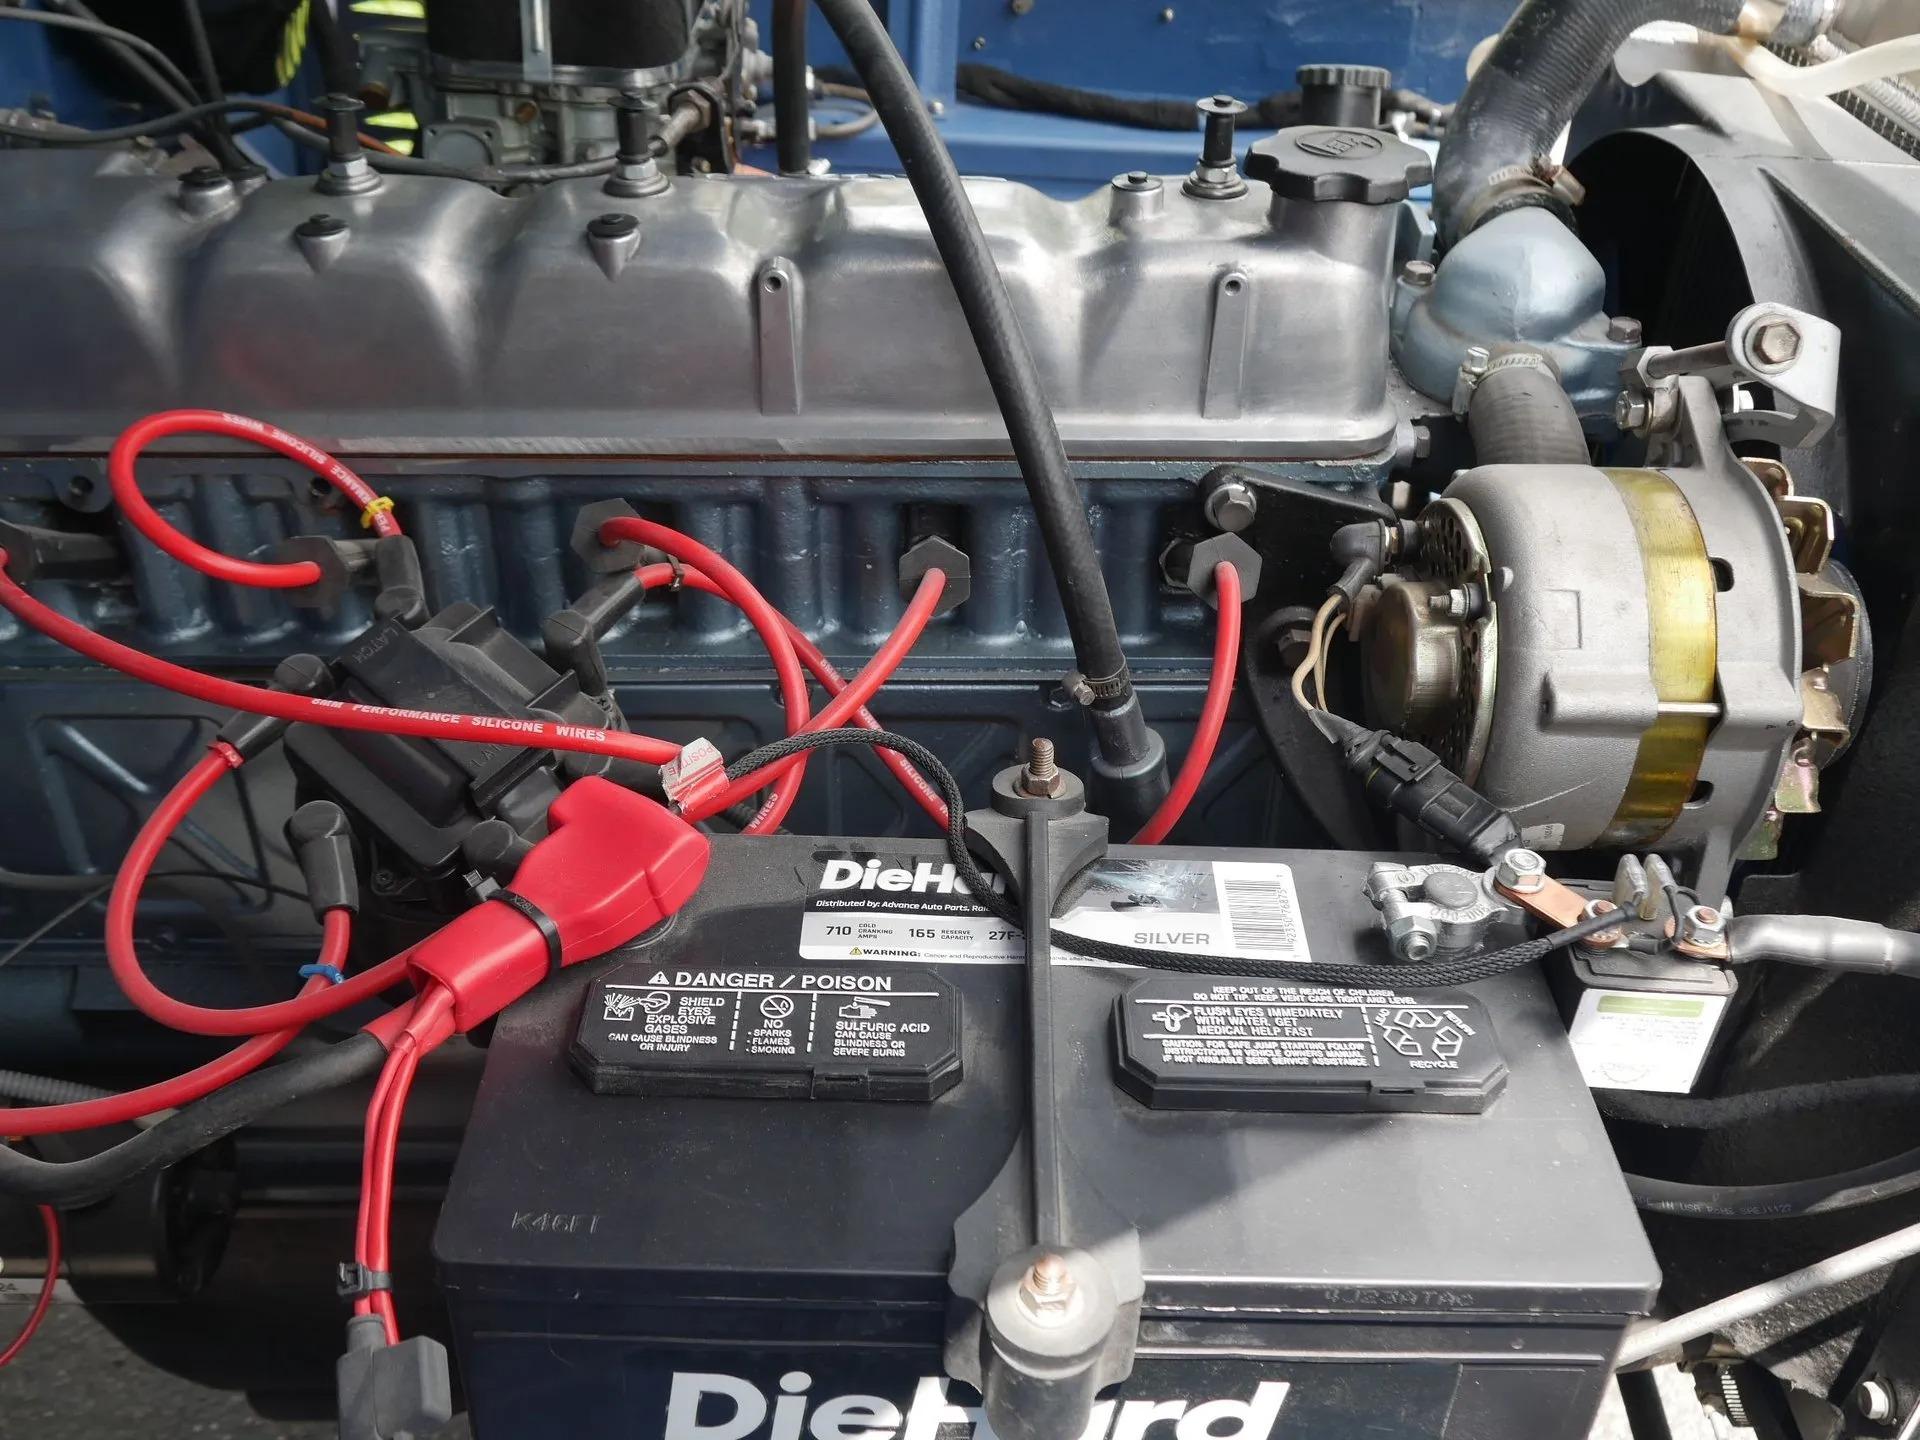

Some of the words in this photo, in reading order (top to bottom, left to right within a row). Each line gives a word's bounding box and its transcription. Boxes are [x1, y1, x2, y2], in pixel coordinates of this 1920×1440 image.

[271, 428, 328, 464] SILICONE
[352, 704, 462, 724] PERFORMANCE
[471, 717, 544, 733] SILICONE
[555, 725, 606, 742] WIRES
[899, 759, 936, 802] SILICONE
[815, 899, 866, 907] Distributed
[866, 900, 881, 909] by:
[881, 901, 920, 910] Advance
[920, 902, 943, 910] Auto
[826, 926, 852, 936] 710
[908, 928, 936, 939] 165
[1133, 932, 1211, 946] SILVER
[863, 949, 921, 957] WARNING:
[674, 971, 775, 988] DANGER
[801, 974, 892, 991] POISON
[1212, 985, 1238, 994] KEEP
[1239, 986, 1259, 995] OUT
[1261, 986, 1275, 995] OF
[1277, 987, 1298, 996] THE
[1299, 987, 1331, 996] REACH
[1332, 988, 1347, 996] OF
[679, 996, 725, 1007] SHIELD
[1193, 992, 1208, 1000] DO
[1209, 993, 1230, 1001] NOT
[1254, 993, 1279, 1002] KEEP
[678, 1006, 712, 1016] EYES
[1192, 1006, 1232, 1016] FLUSH
[1233, 1007, 1265, 1017] EYES
[1266, 1007, 1343, 1019] IMMEDIATELY
[645, 1014, 717, 1025] EXPLOSIVE
[763, 1019, 784, 1029] NO
[1194, 1016, 1226, 1026] WITH
[1273, 1017, 1298, 1027] GET
[644, 1024, 688, 1034] GASES
[835, 1020, 897, 1033] SULFURIC
[899, 1023, 931, 1033] ACID
[1196, 1025, 1248, 1036] MEDICAL
[1250, 1026, 1282, 1036] HELP
[1283, 1027, 1314, 1037] FAST
[607, 1032, 629, 1042] CAN
[630, 1034, 663, 1043] CAUSE
[665, 1035, 718, 1044] BLINDNESS
[753, 1029, 792, 1038] SPARKS
[834, 1031, 857, 1039] CAN
[859, 1031, 892, 1040] CAUSE
[752, 1037, 791, 1046] FLAMES
[834, 1039, 888, 1048] BLINDNESS
[890, 1041, 906, 1049] OR
[1205, 1040, 1226, 1049] FOR
[639, 1042, 654, 1051] OR
[656, 1043, 691, 1052] INJURY
[750, 1046, 796, 1055] SMOKING
[833, 1047, 870, 1056] SEVERE
[872, 1048, 906, 1057] BURNS
[1163, 1047, 1231, 1056] INSTRUCTIONS
[1408, 1060, 1460, 1069] RECYCLE
